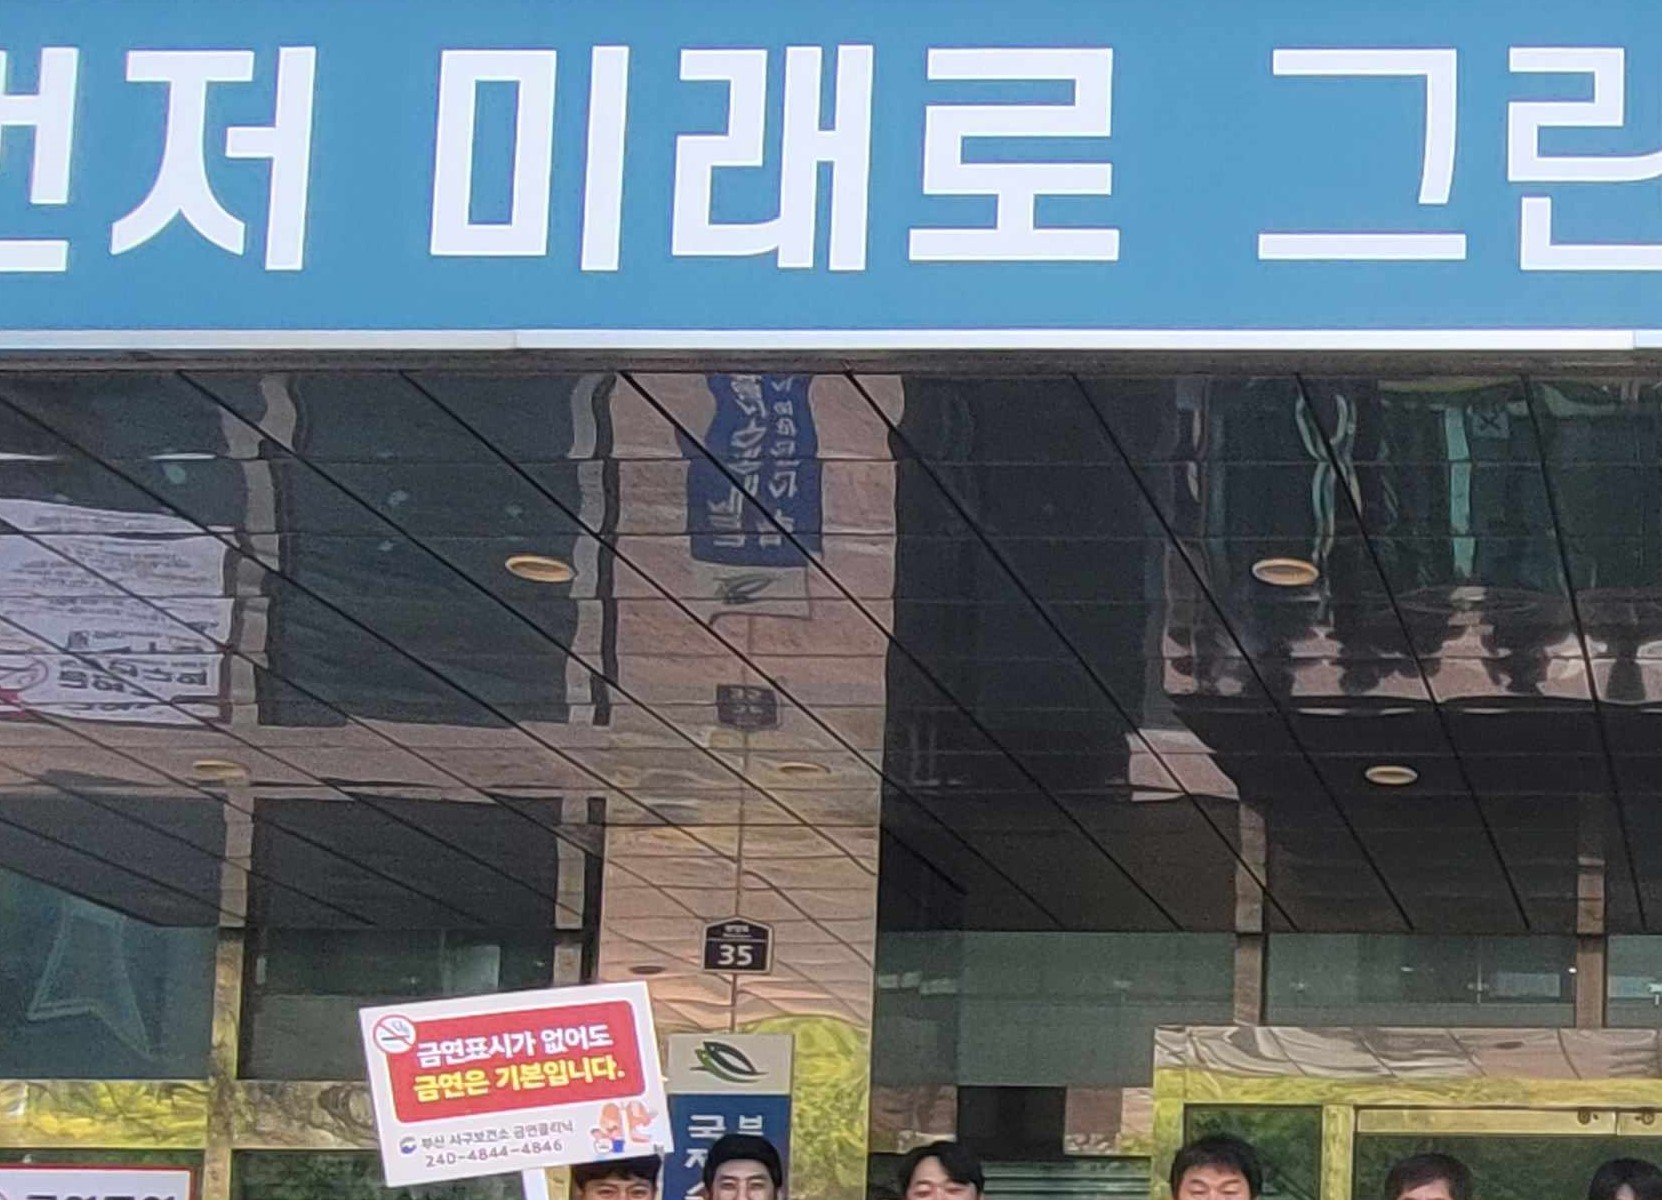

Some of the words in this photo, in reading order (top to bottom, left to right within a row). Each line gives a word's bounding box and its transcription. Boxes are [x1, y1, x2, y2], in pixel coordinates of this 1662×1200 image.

[429, 45, 1121, 272] 미래로
[717, 943, 753, 967] 35
[416, 1034, 535, 1068] 금연표시가
[541, 1024, 613, 1053] 없어도
[413, 1069, 490, 1102] 금연은
[496, 1054, 625, 1090] 기본입니다.
[421, 1135, 445, 1149] 부산
[426, 1139, 563, 1168] 240-4844-4846
